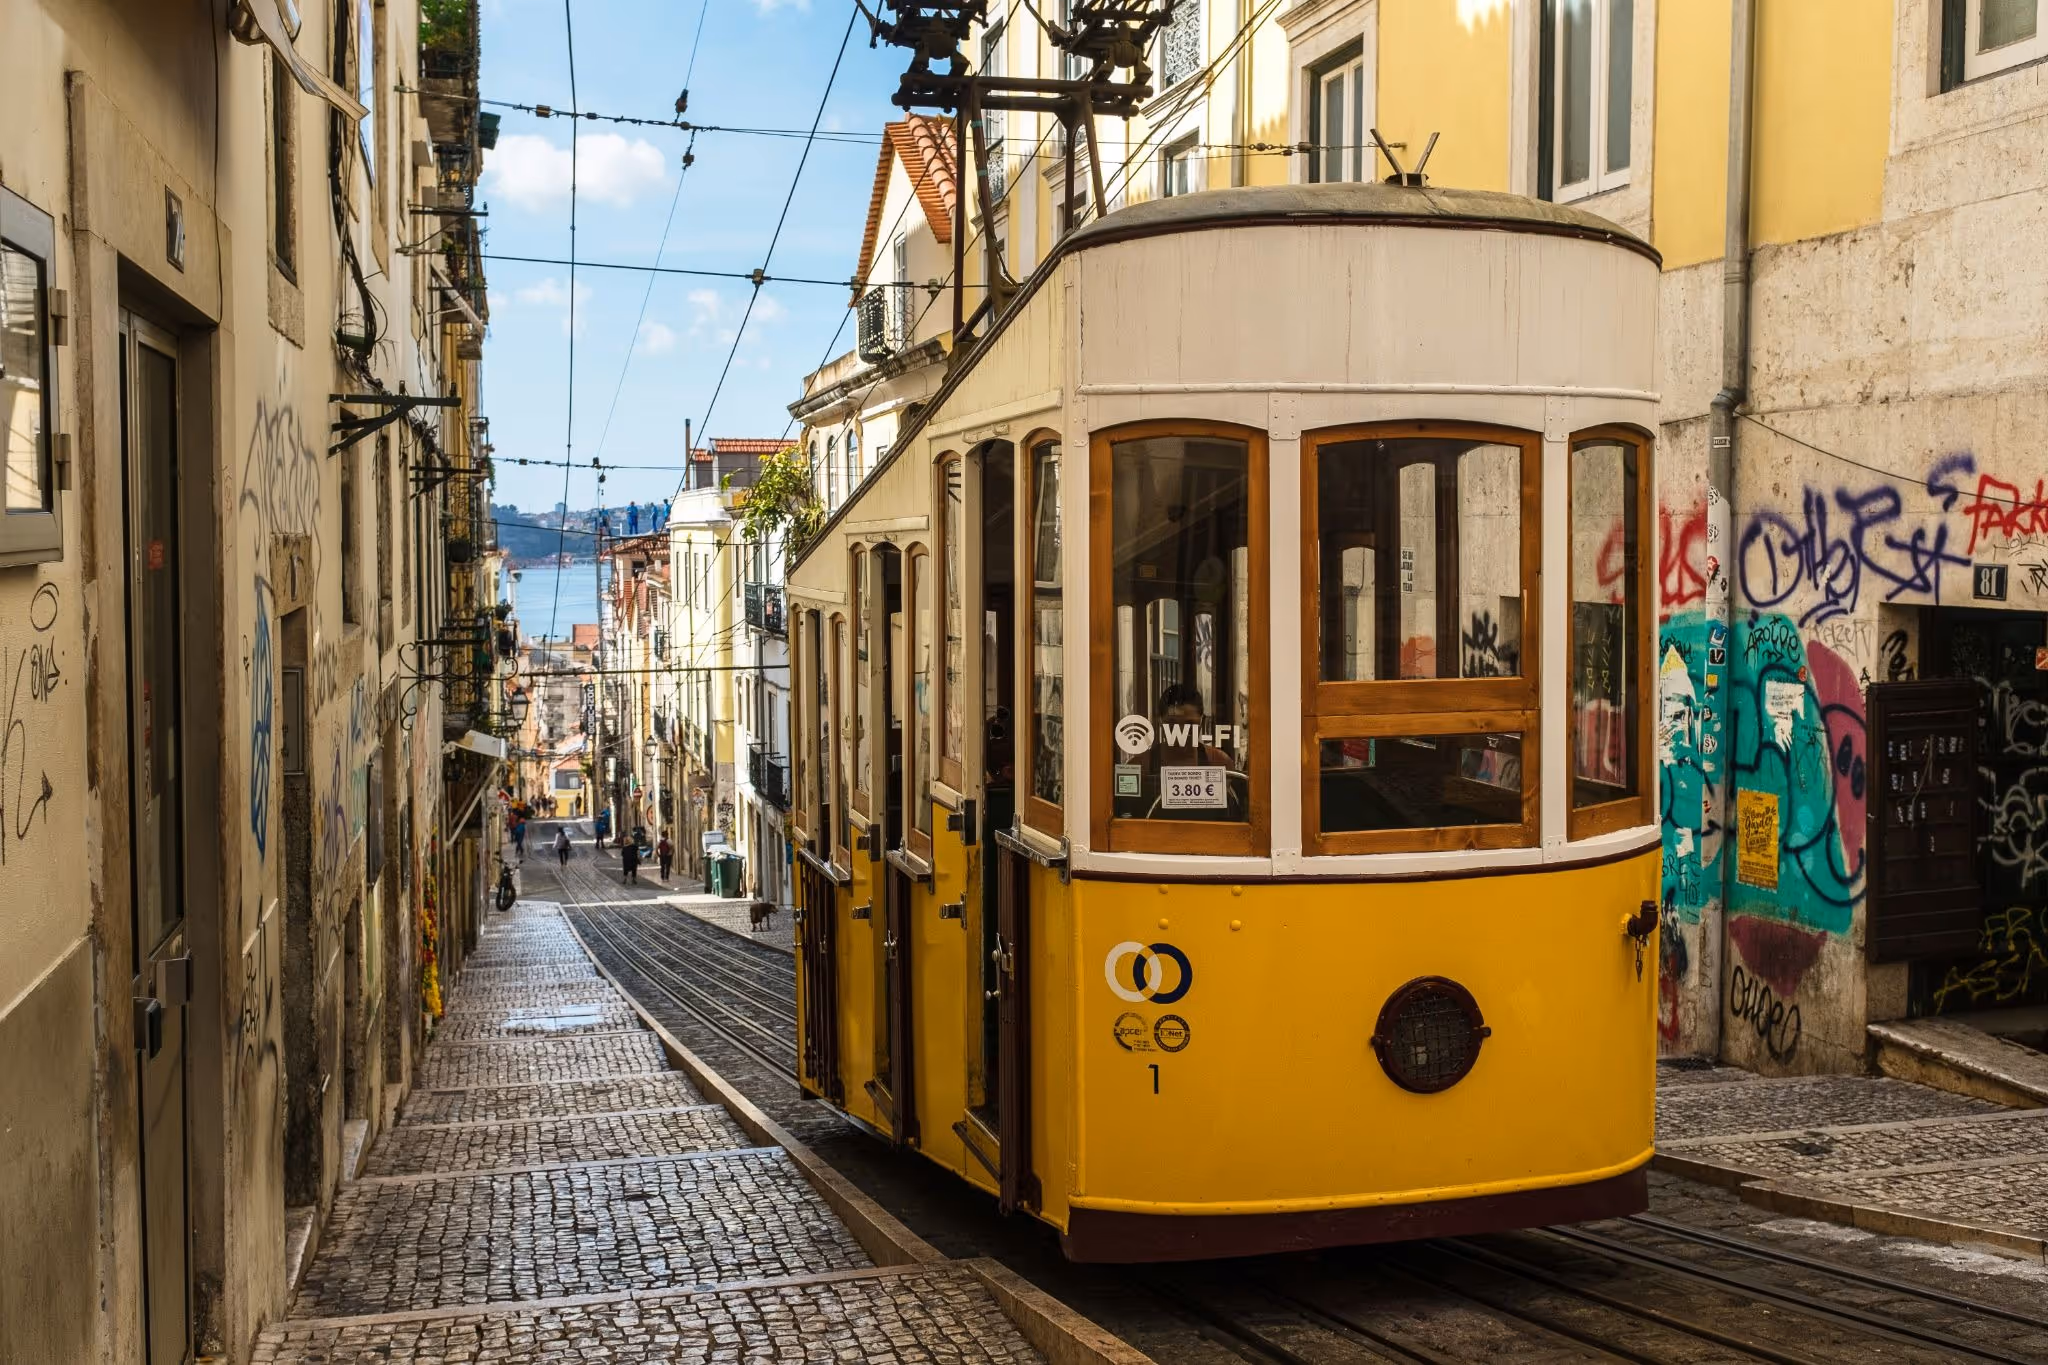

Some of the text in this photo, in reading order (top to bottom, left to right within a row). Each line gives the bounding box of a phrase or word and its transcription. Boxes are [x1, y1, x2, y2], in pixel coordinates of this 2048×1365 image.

[1980, 567, 1999, 597] 81
[1162, 723, 1241, 748] WI-FI
[1172, 784, 1215, 797] 3.80 €
[1148, 1064, 1159, 1094] 1
